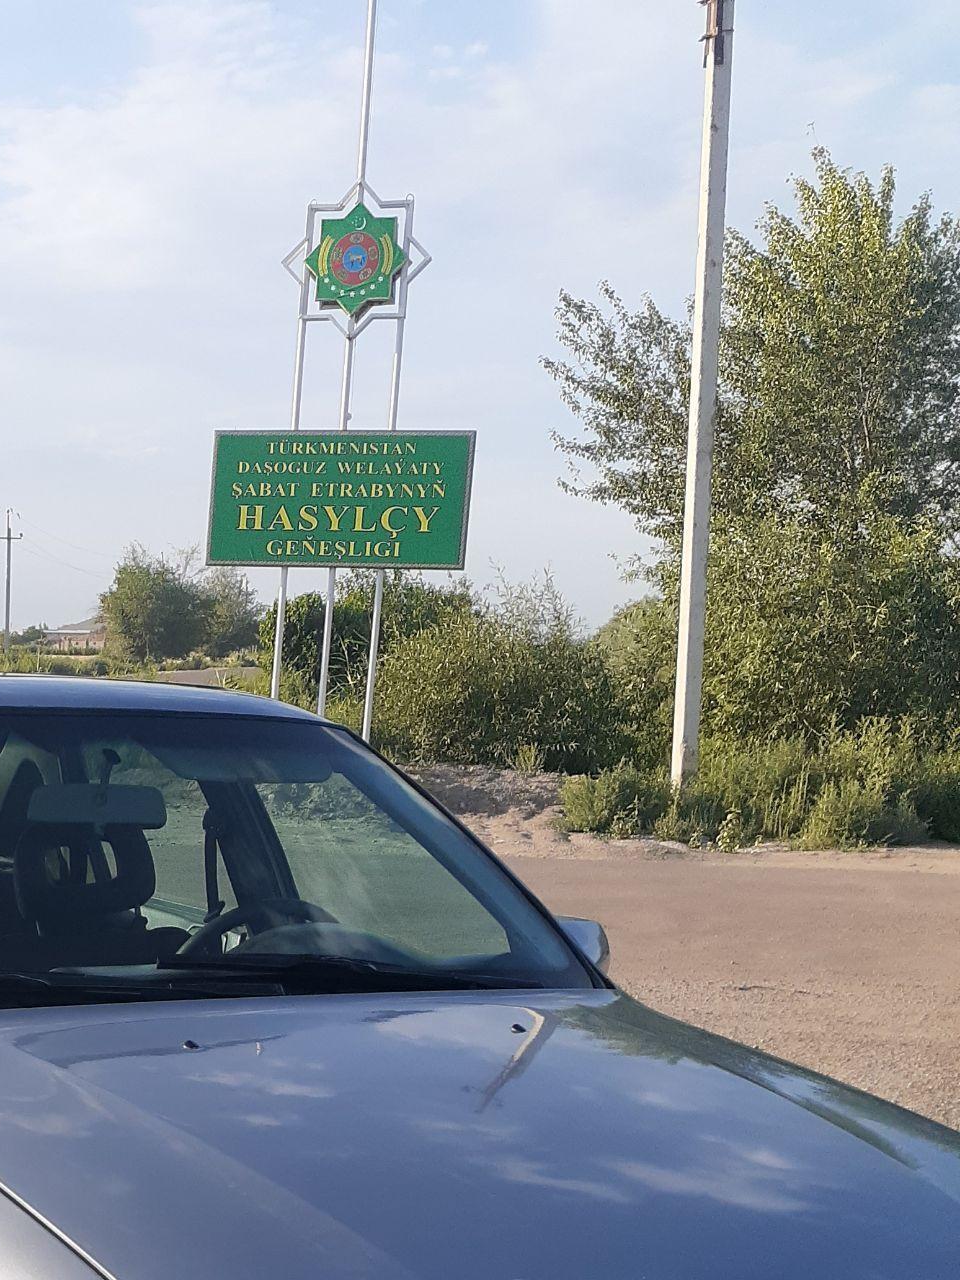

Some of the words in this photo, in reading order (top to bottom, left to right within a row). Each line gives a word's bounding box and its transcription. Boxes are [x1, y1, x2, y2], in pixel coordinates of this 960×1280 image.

[267, 440, 417, 455] TÜRKMENISTAN
[237, 461, 327, 476] DAŞOGUZ
[338, 458, 445, 475] WELAÝATY
[231, 482, 300, 499] ŞABAT
[311, 479, 446, 498] ETRABYNYŇ
[236, 504, 440, 538] HASYLÇY
[266, 535, 400, 559] GEŇEŞLIGI
